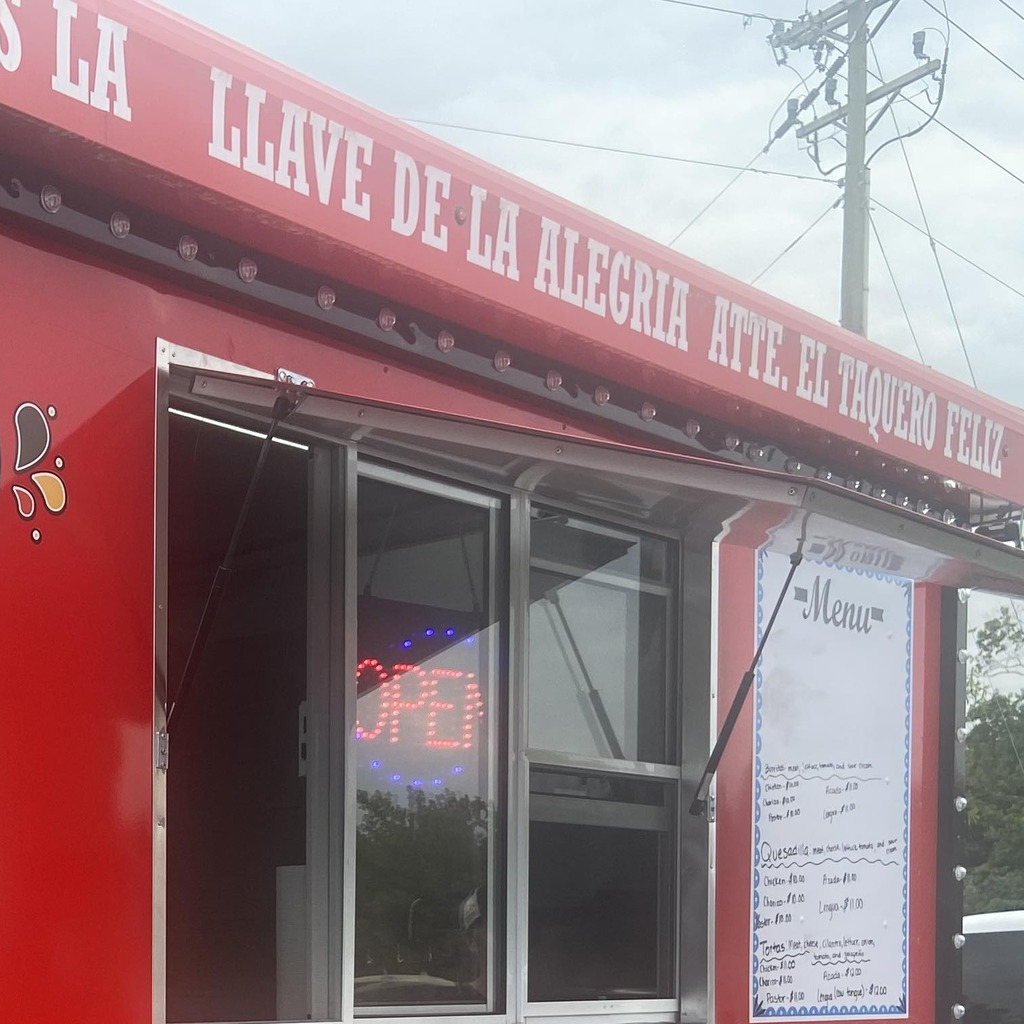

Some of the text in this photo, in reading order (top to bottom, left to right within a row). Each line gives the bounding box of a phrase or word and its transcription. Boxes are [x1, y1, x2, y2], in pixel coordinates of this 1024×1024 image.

[51, 0, 132, 122] LA
[209, 66, 373, 221] LLAVE
[391, 150, 451, 251] DE
[467, 185, 520, 281] LA
[534, 216, 690, 351] ALEGRIA
[708, 297, 787, 391] ATTE.
[797, 334, 829, 408] EL
[839, 350, 936, 451] TAQUERO
[944, 402, 1004, 478] FELIZ
[803, 576, 872, 634] Menu
